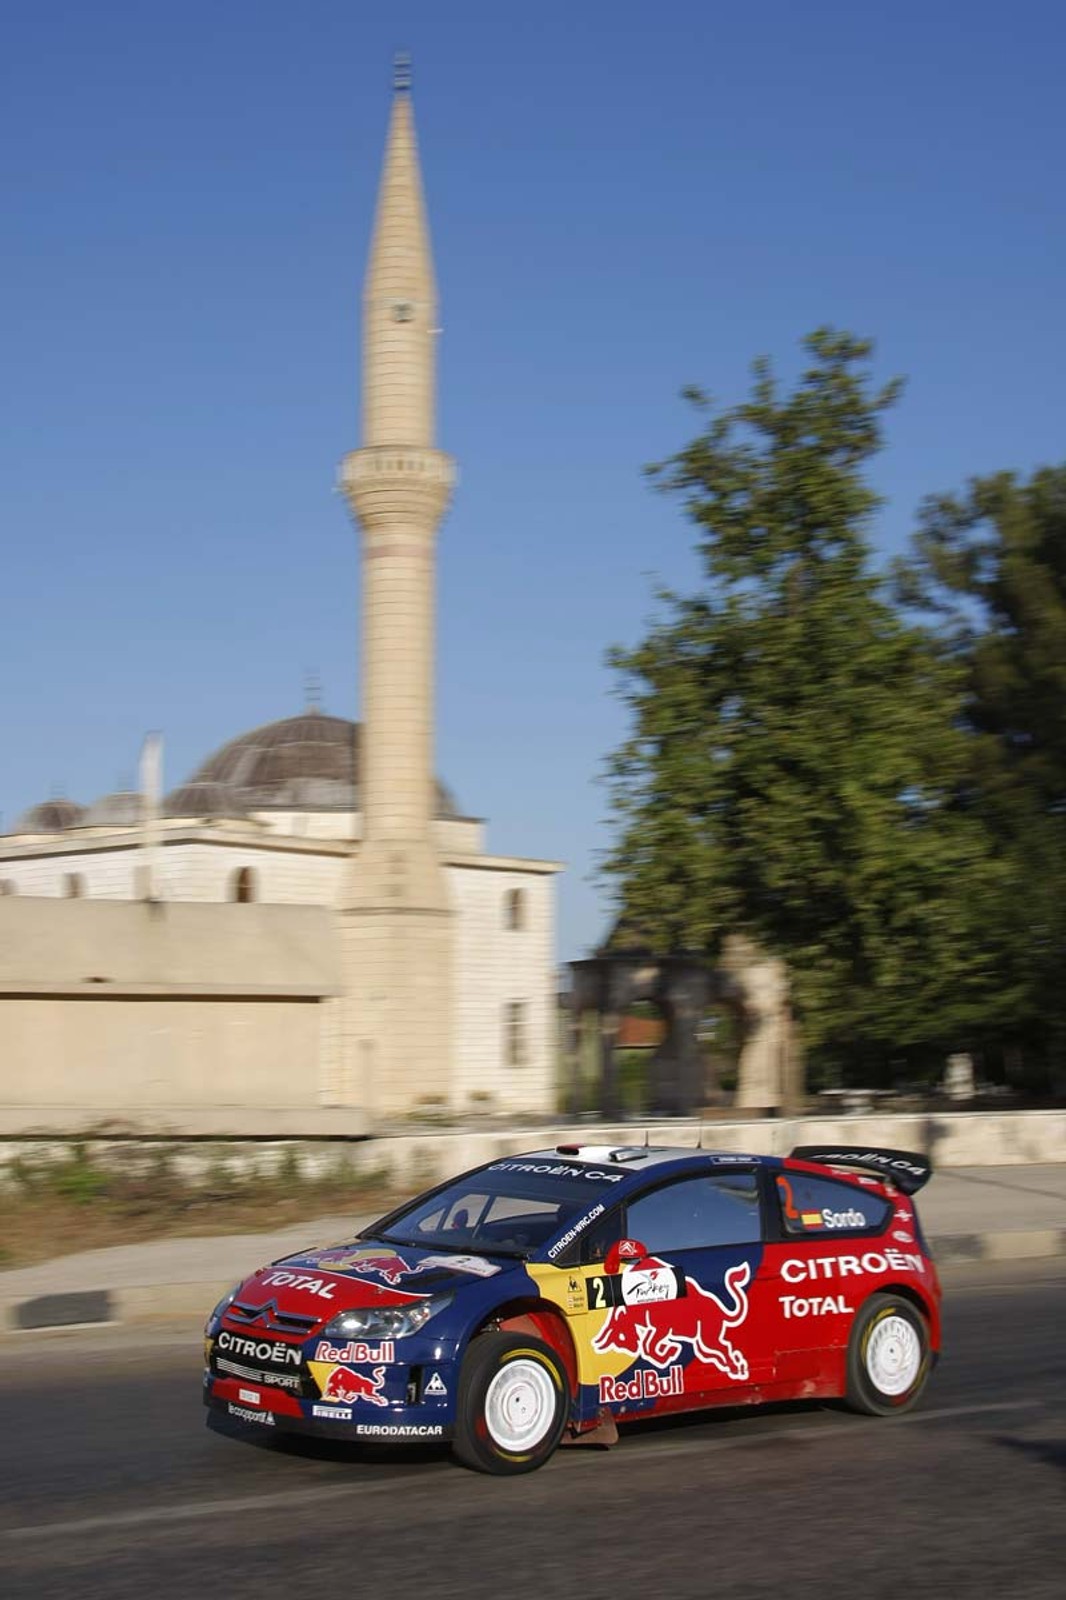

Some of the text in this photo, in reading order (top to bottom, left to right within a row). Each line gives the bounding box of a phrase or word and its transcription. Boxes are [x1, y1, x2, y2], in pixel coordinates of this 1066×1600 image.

[488, 1163, 624, 1182] CITROËN C4
[890, 1161, 927, 1175] C4
[822, 1208, 866, 1228] Sordo
[547, 1204, 605, 1258] CITROEN-WRC.COM
[780, 1248, 925, 1283] CITROËN
[262, 1271, 337, 1299] TOTAL
[593, 1277, 606, 1308] 2
[778, 1295, 855, 1318] TOTAL
[218, 1332, 302, 1365] CITROËN
[264, 1375, 300, 1388] SPORT
[356, 1425, 443, 1435] EURODATACAR
